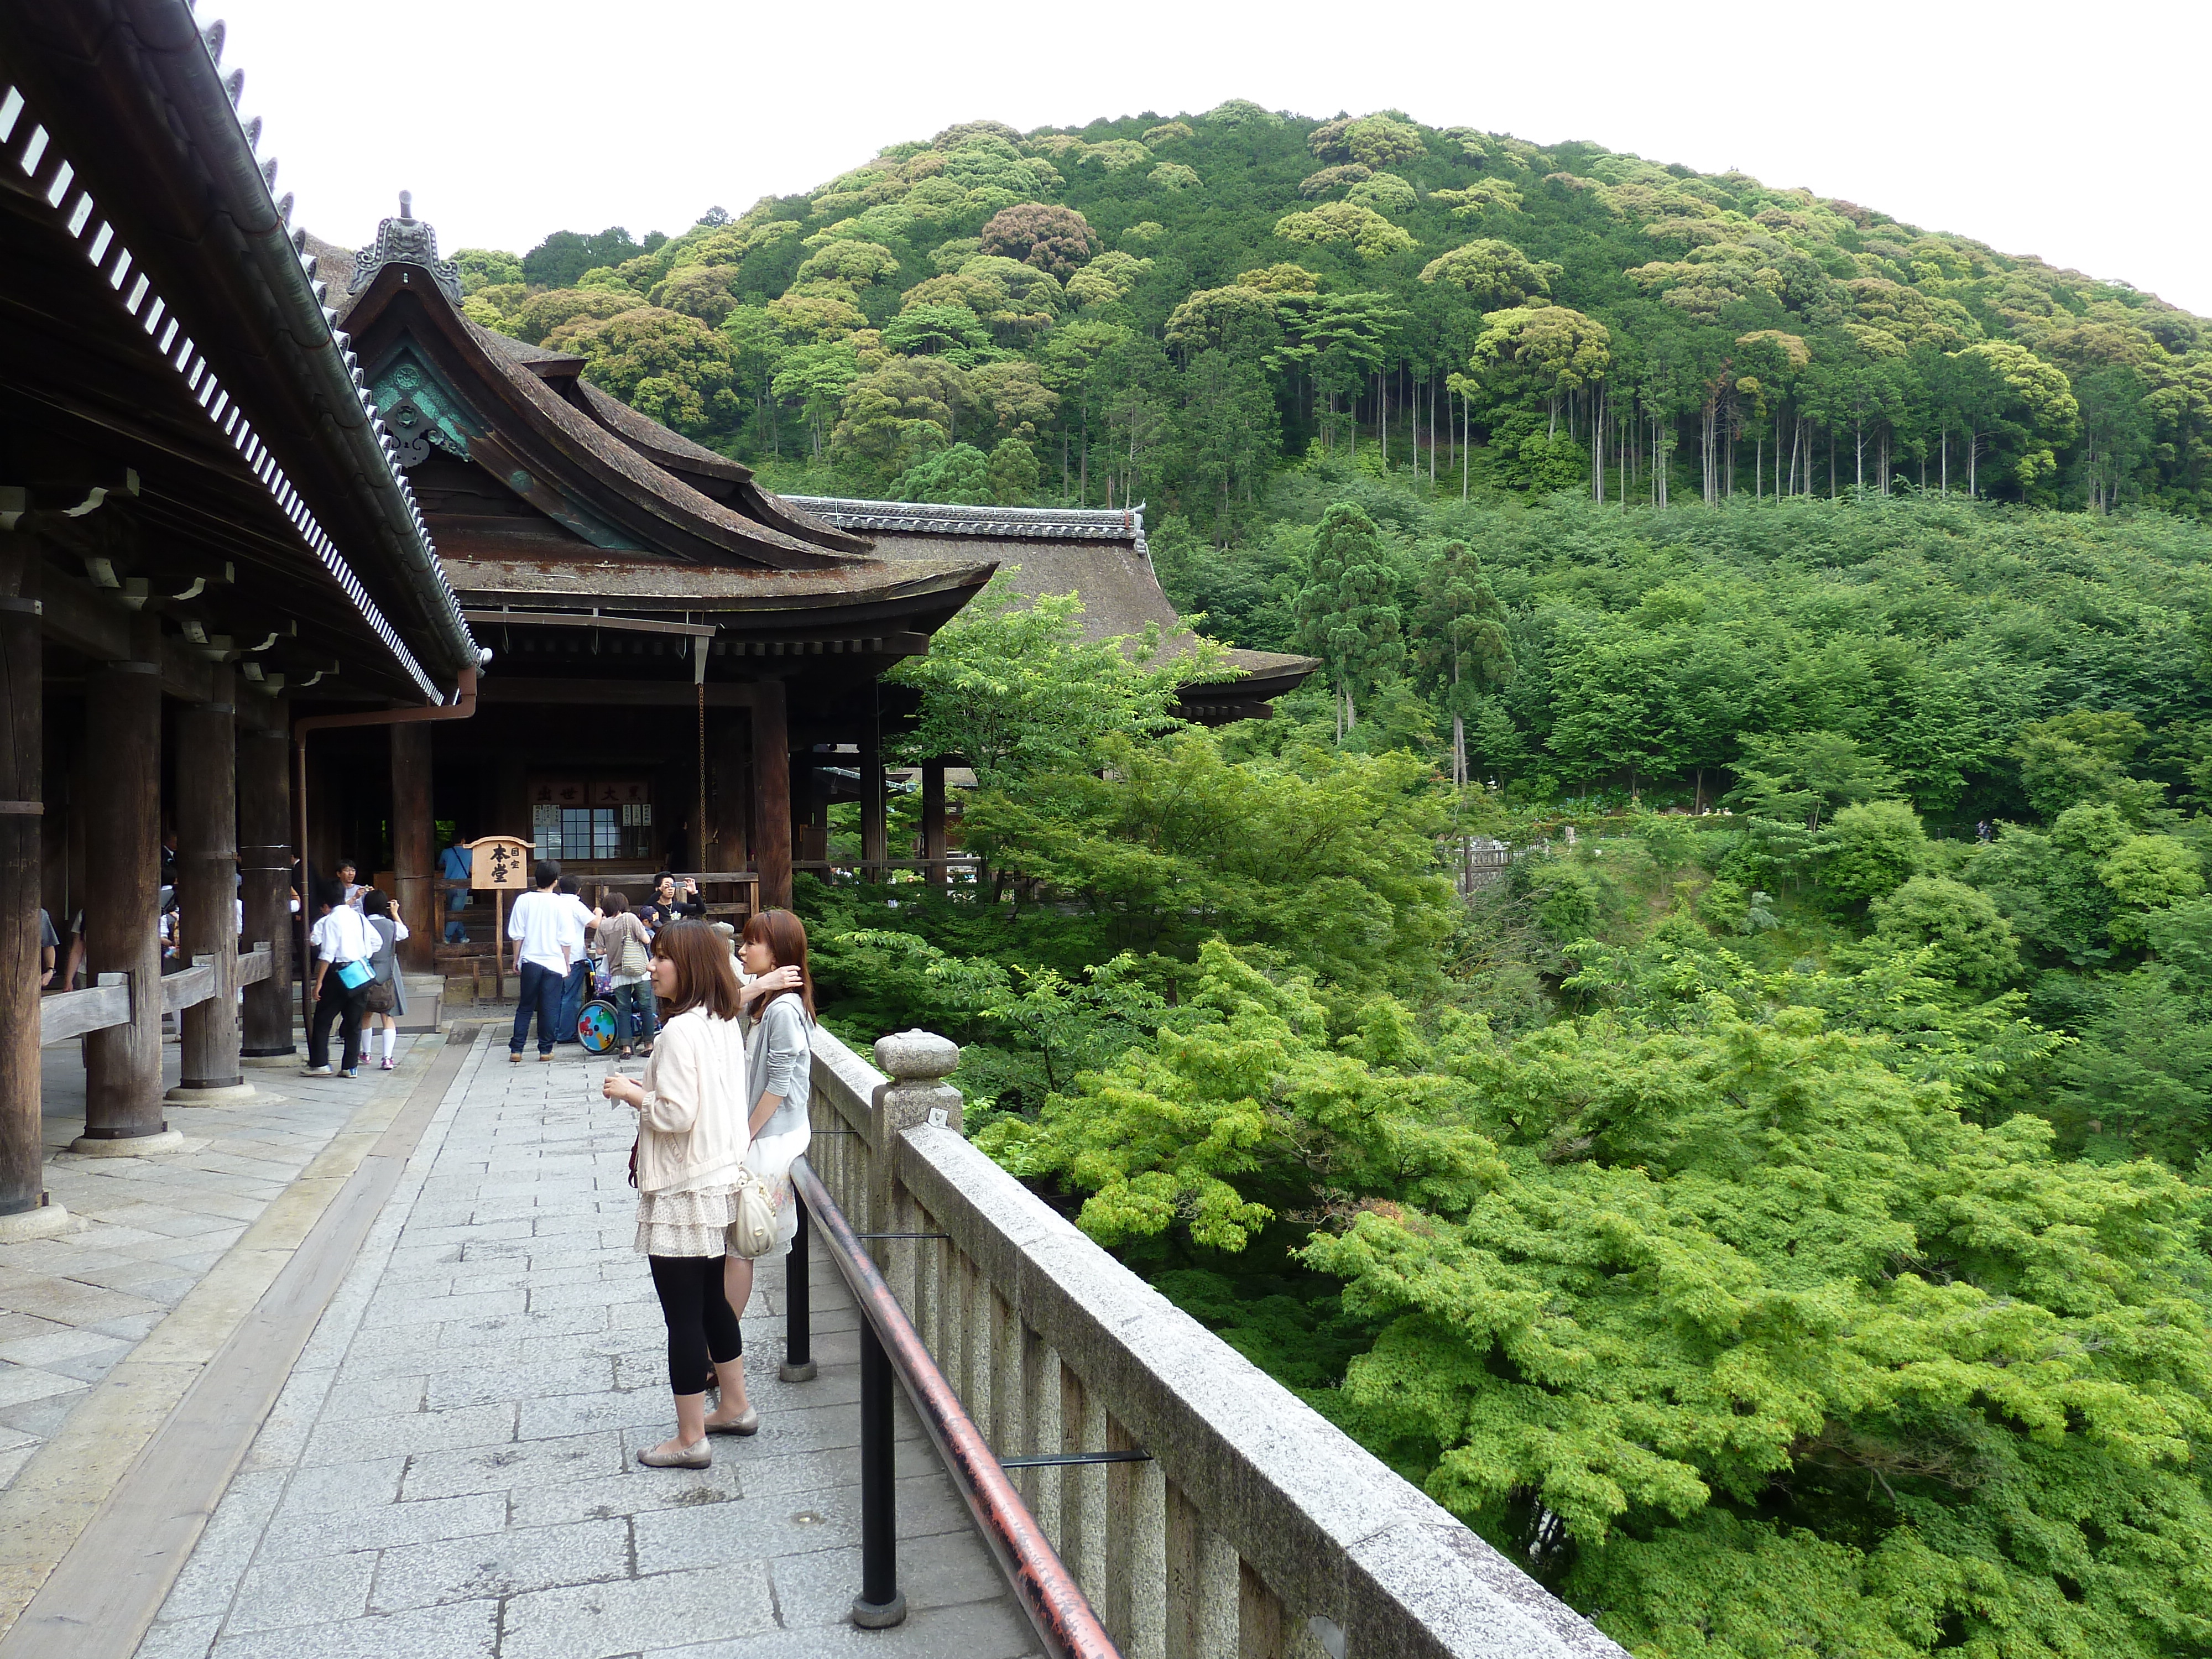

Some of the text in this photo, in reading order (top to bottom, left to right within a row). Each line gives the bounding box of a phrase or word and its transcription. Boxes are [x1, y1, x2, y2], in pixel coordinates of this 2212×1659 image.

[538, 785, 578, 801] 出世
[490, 843, 510, 883] 本堂
[510, 847, 520, 869] 国宝
